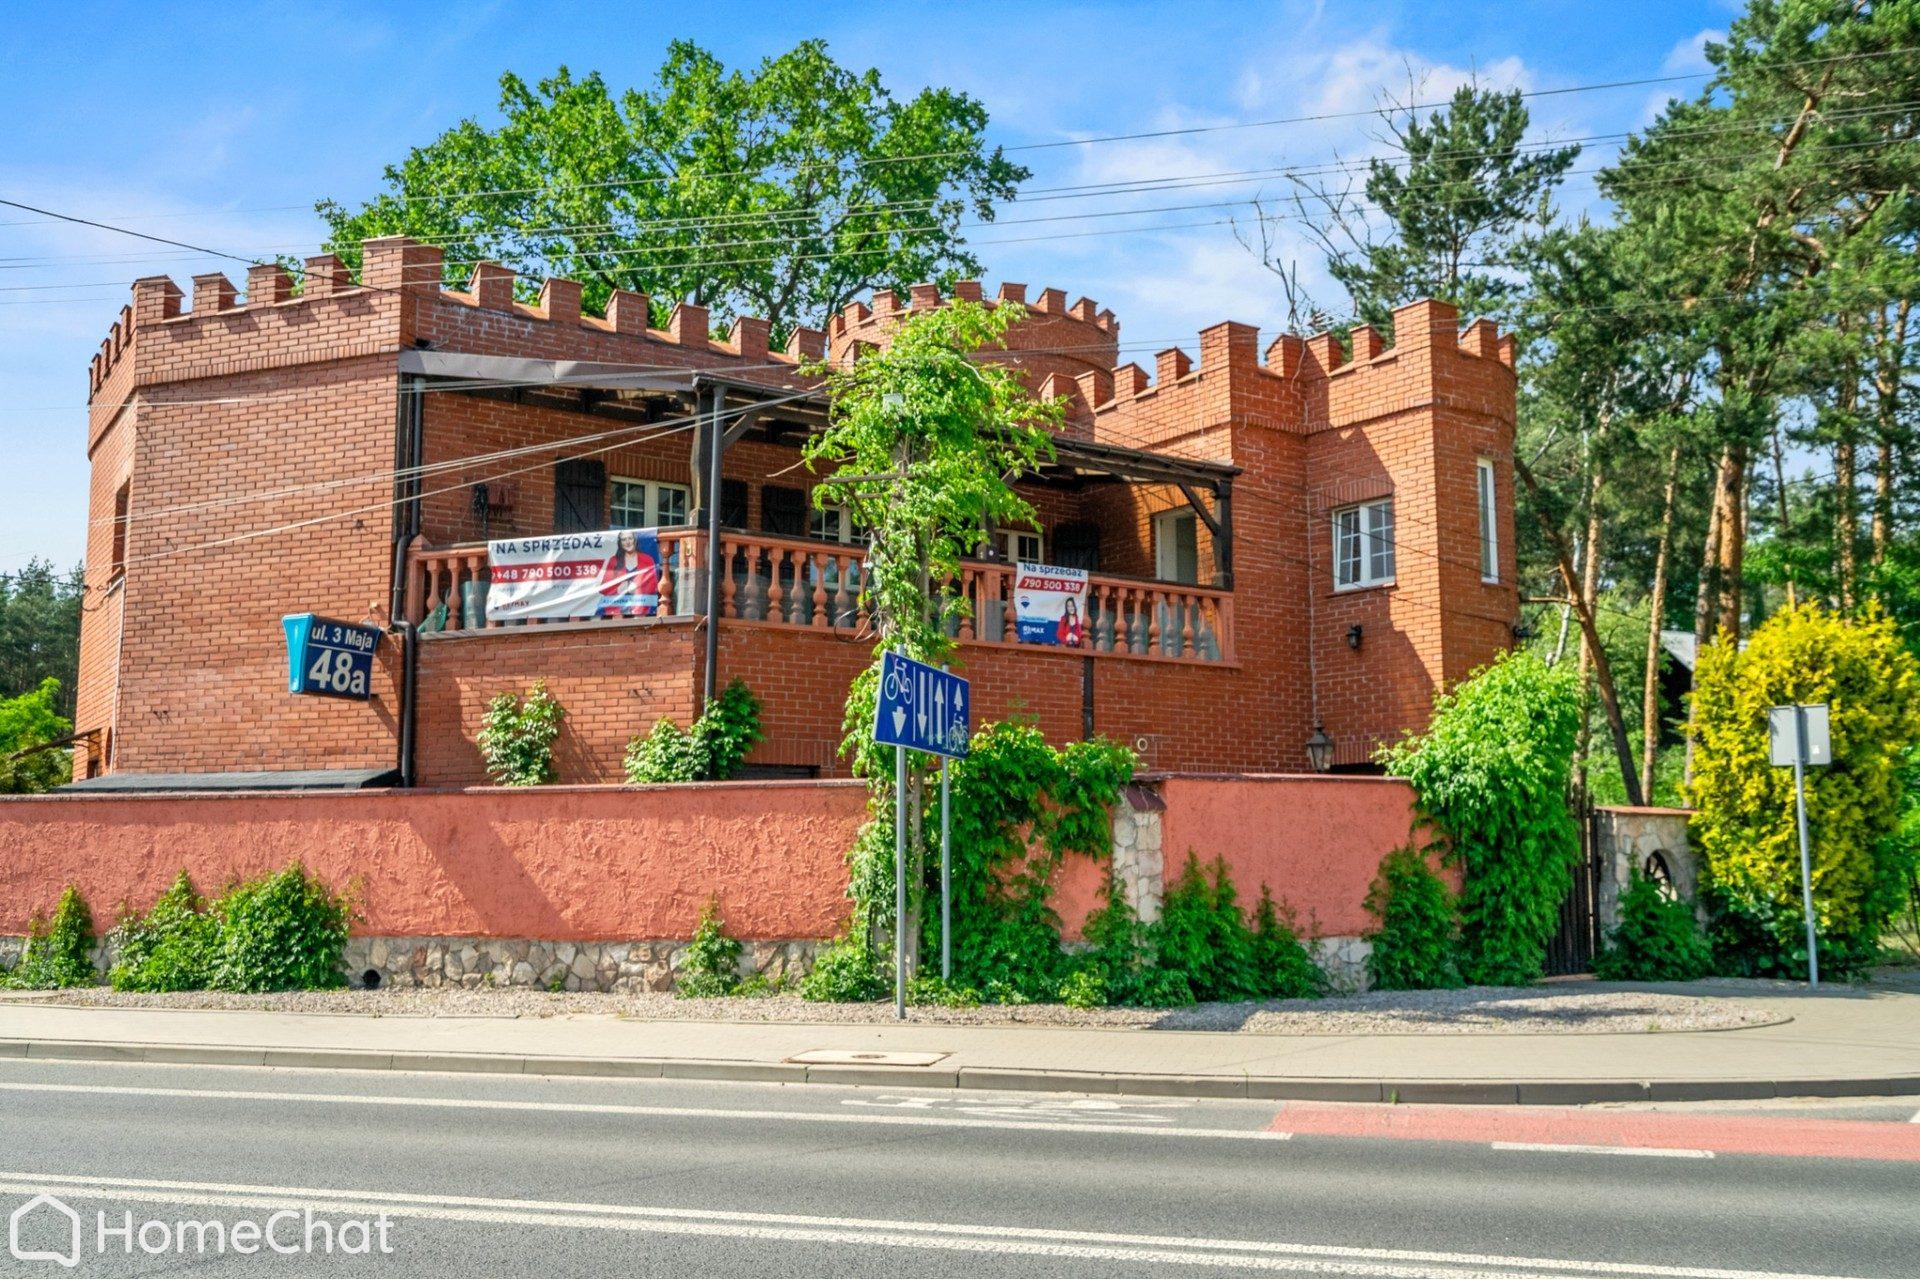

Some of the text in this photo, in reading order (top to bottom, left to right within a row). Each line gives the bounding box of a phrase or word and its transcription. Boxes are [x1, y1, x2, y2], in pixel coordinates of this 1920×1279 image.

[496, 533, 603, 554] NA SPRZEDAŻ
[496, 563, 597, 580] +48 790 500 338
[1023, 563, 1037, 573] Na
[1023, 578, 1081, 593] 790 500 338
[311, 625, 373, 651] ul. 3 Maja
[308, 649, 366, 694] 48a
